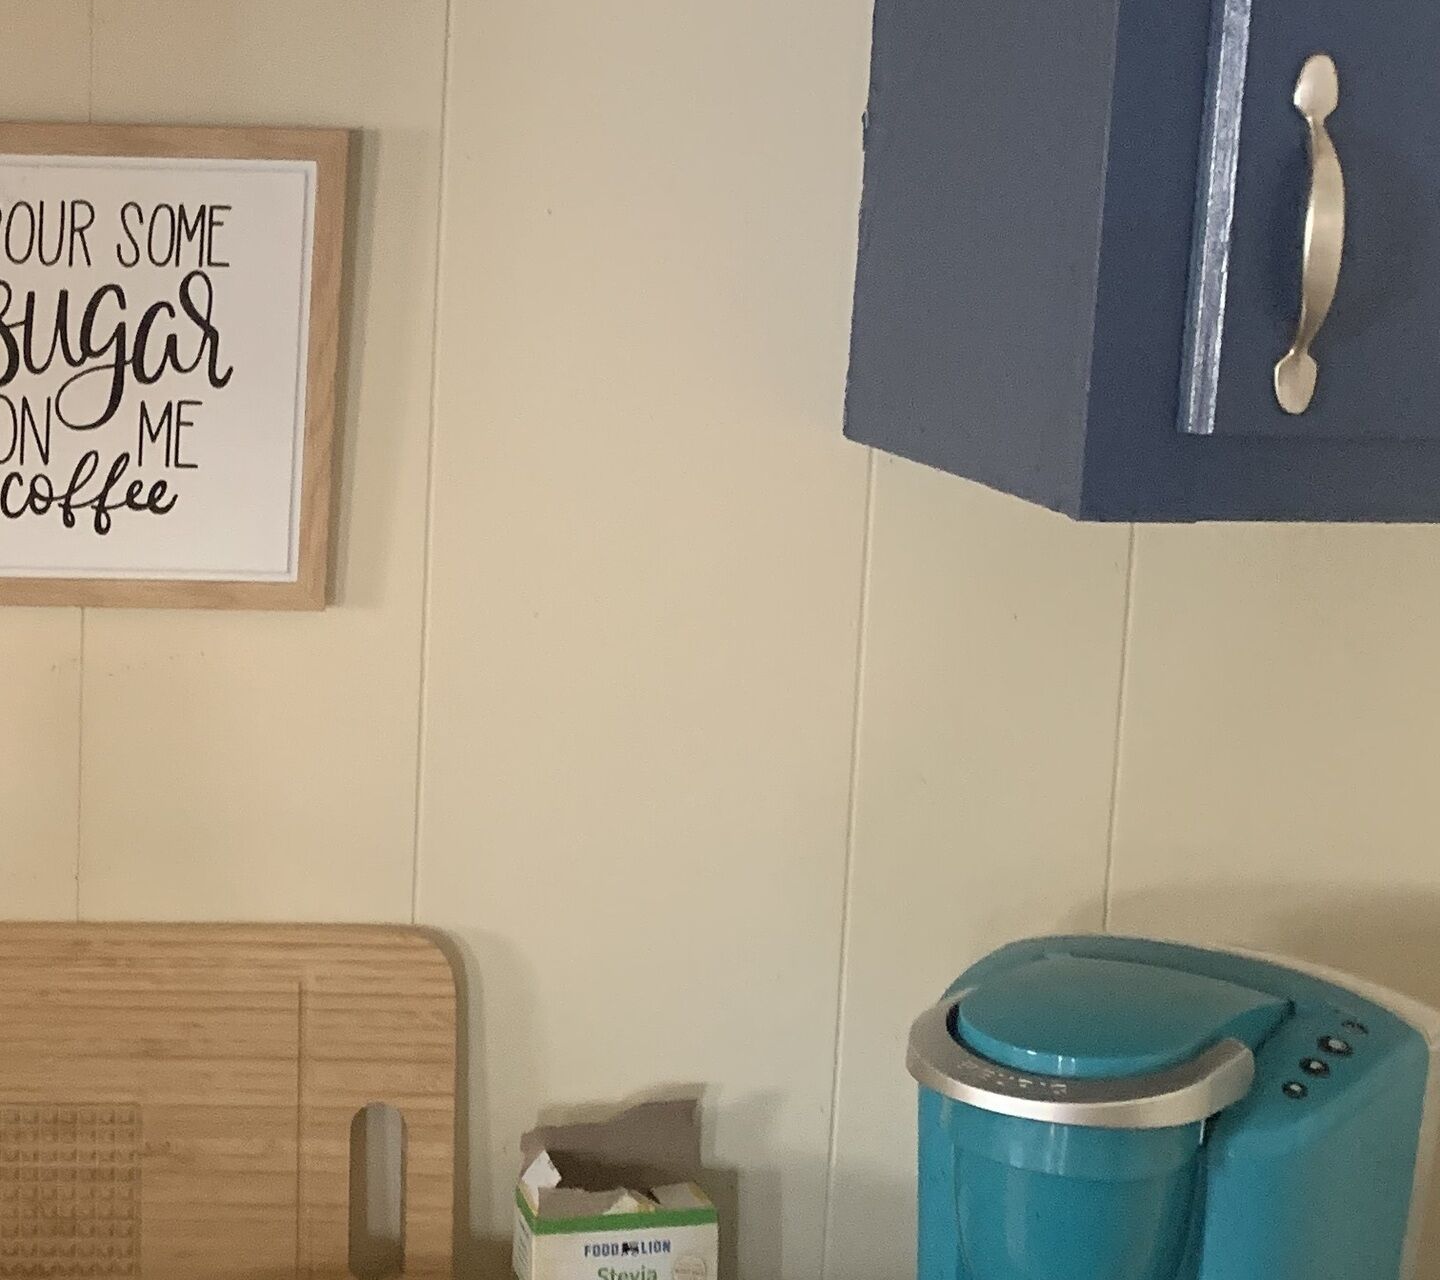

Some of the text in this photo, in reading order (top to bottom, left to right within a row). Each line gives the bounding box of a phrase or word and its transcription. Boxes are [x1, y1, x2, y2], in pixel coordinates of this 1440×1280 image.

[116, 201, 233, 268] SOME
[138, 399, 204, 470] ME
[583, 1239, 672, 1258] FOOD LION
